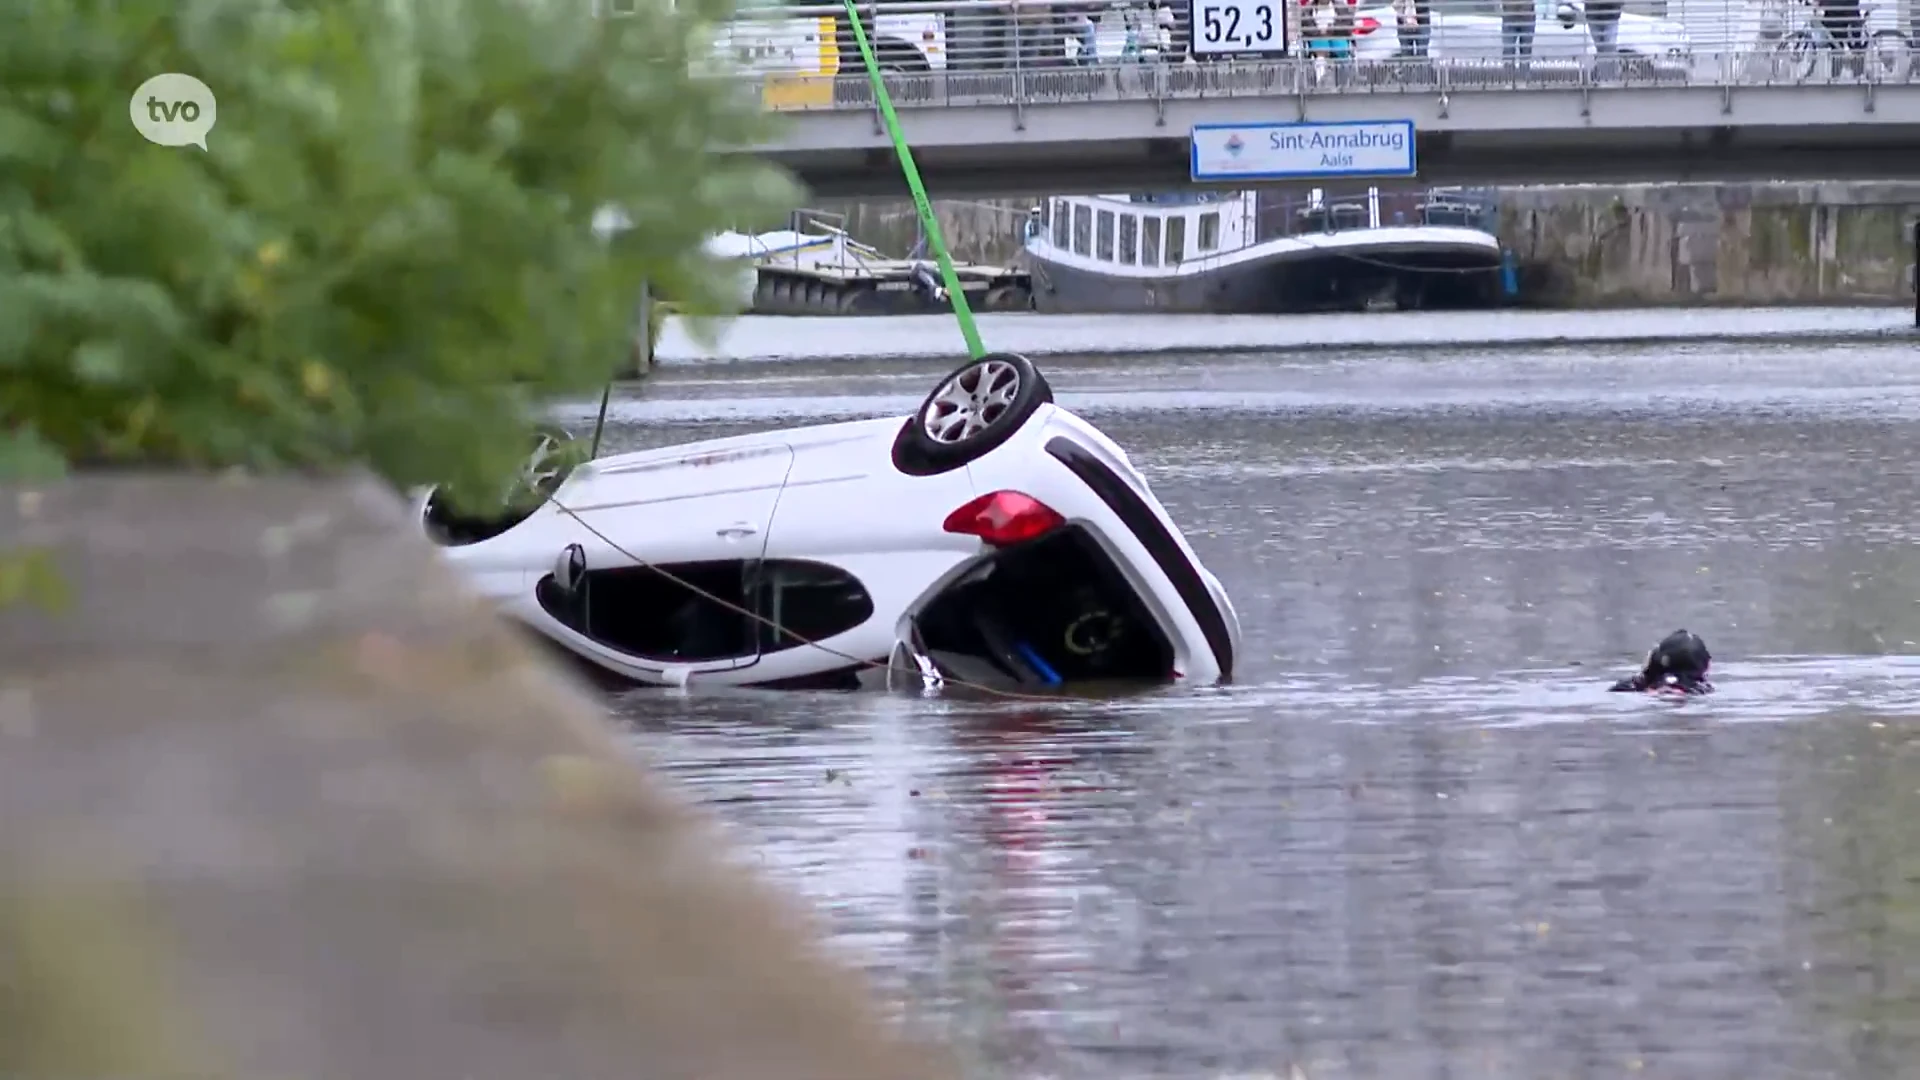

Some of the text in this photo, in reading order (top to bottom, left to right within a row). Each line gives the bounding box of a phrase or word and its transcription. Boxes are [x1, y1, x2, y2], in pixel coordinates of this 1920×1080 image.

[1204, 5, 1272, 47] 52,3
[1269, 129, 1404, 151] Sint-Annabrug
[1320, 153, 1354, 167] Aalst
